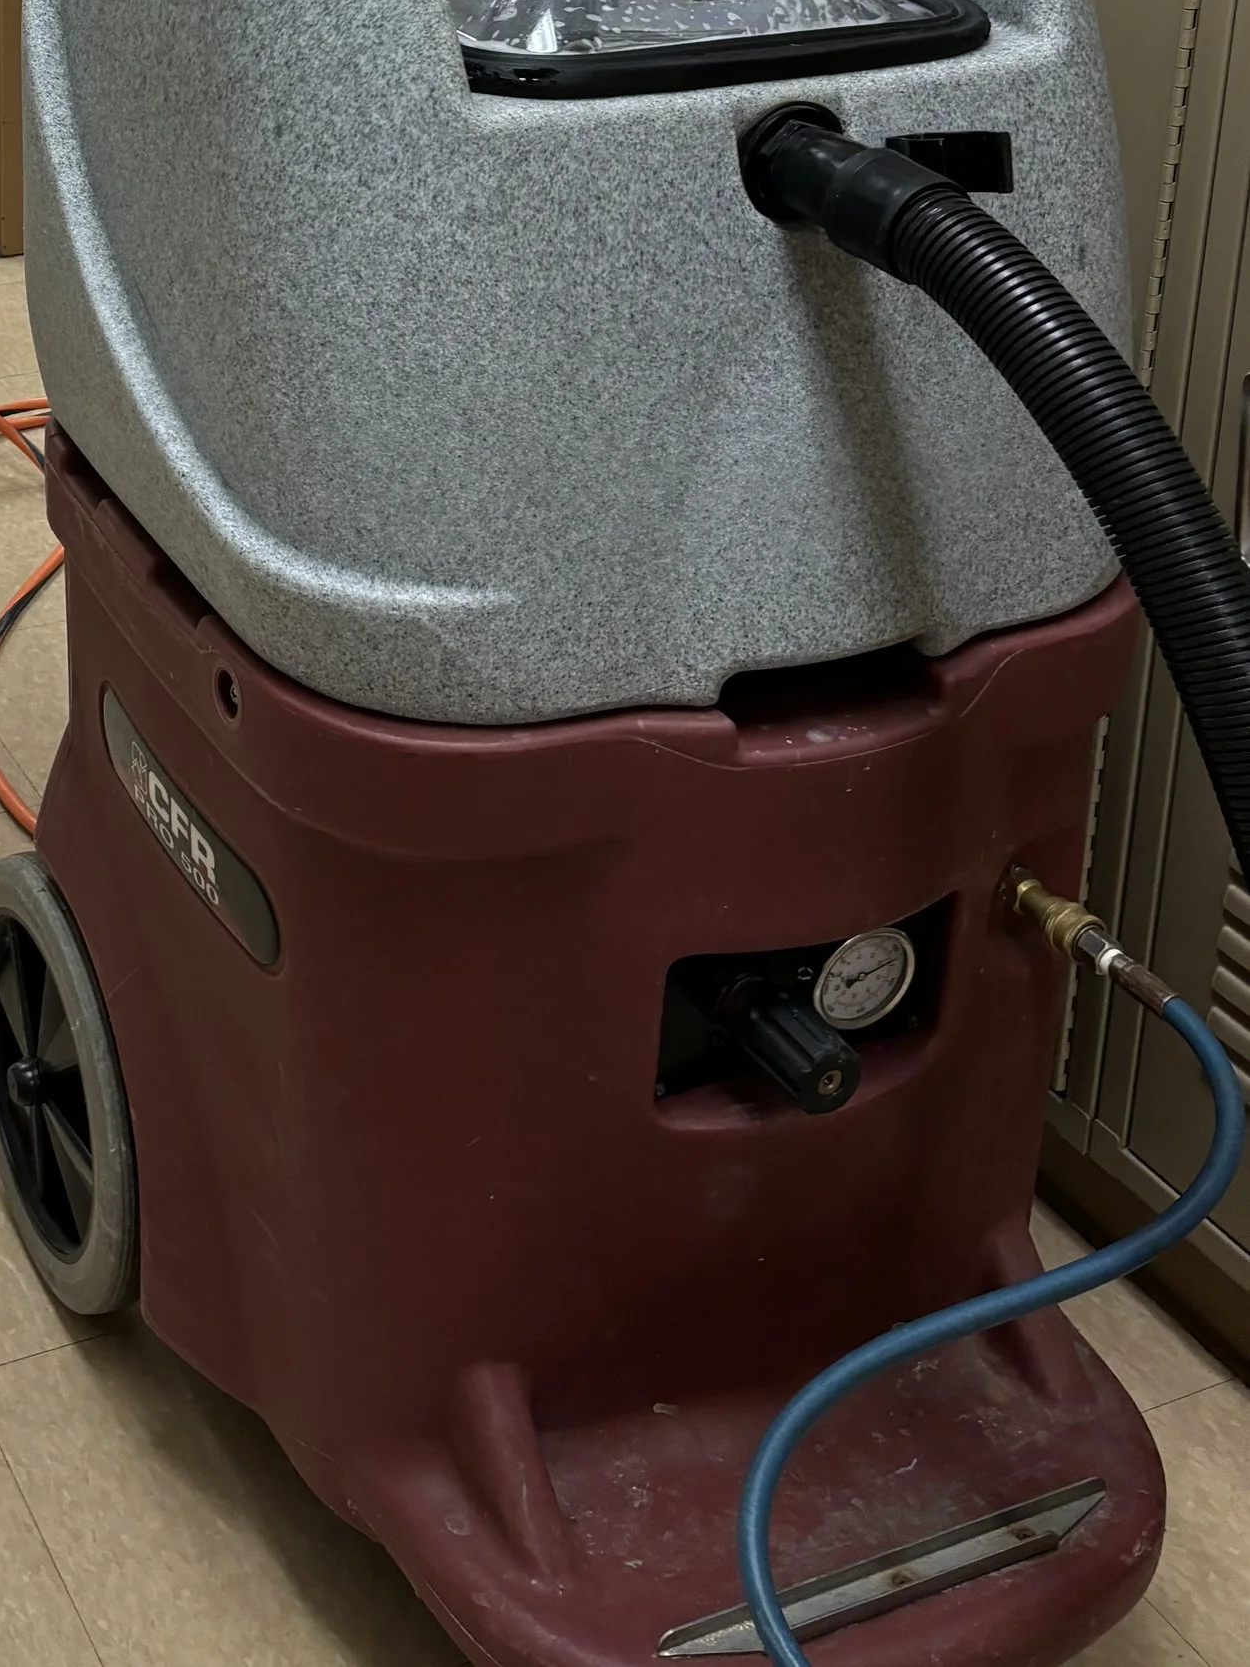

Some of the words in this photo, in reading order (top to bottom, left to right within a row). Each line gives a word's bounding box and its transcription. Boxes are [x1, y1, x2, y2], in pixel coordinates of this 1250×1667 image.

[134, 785, 175, 850] PRO
[181, 850, 219, 906] 500
[148, 770, 216, 885] CFR
